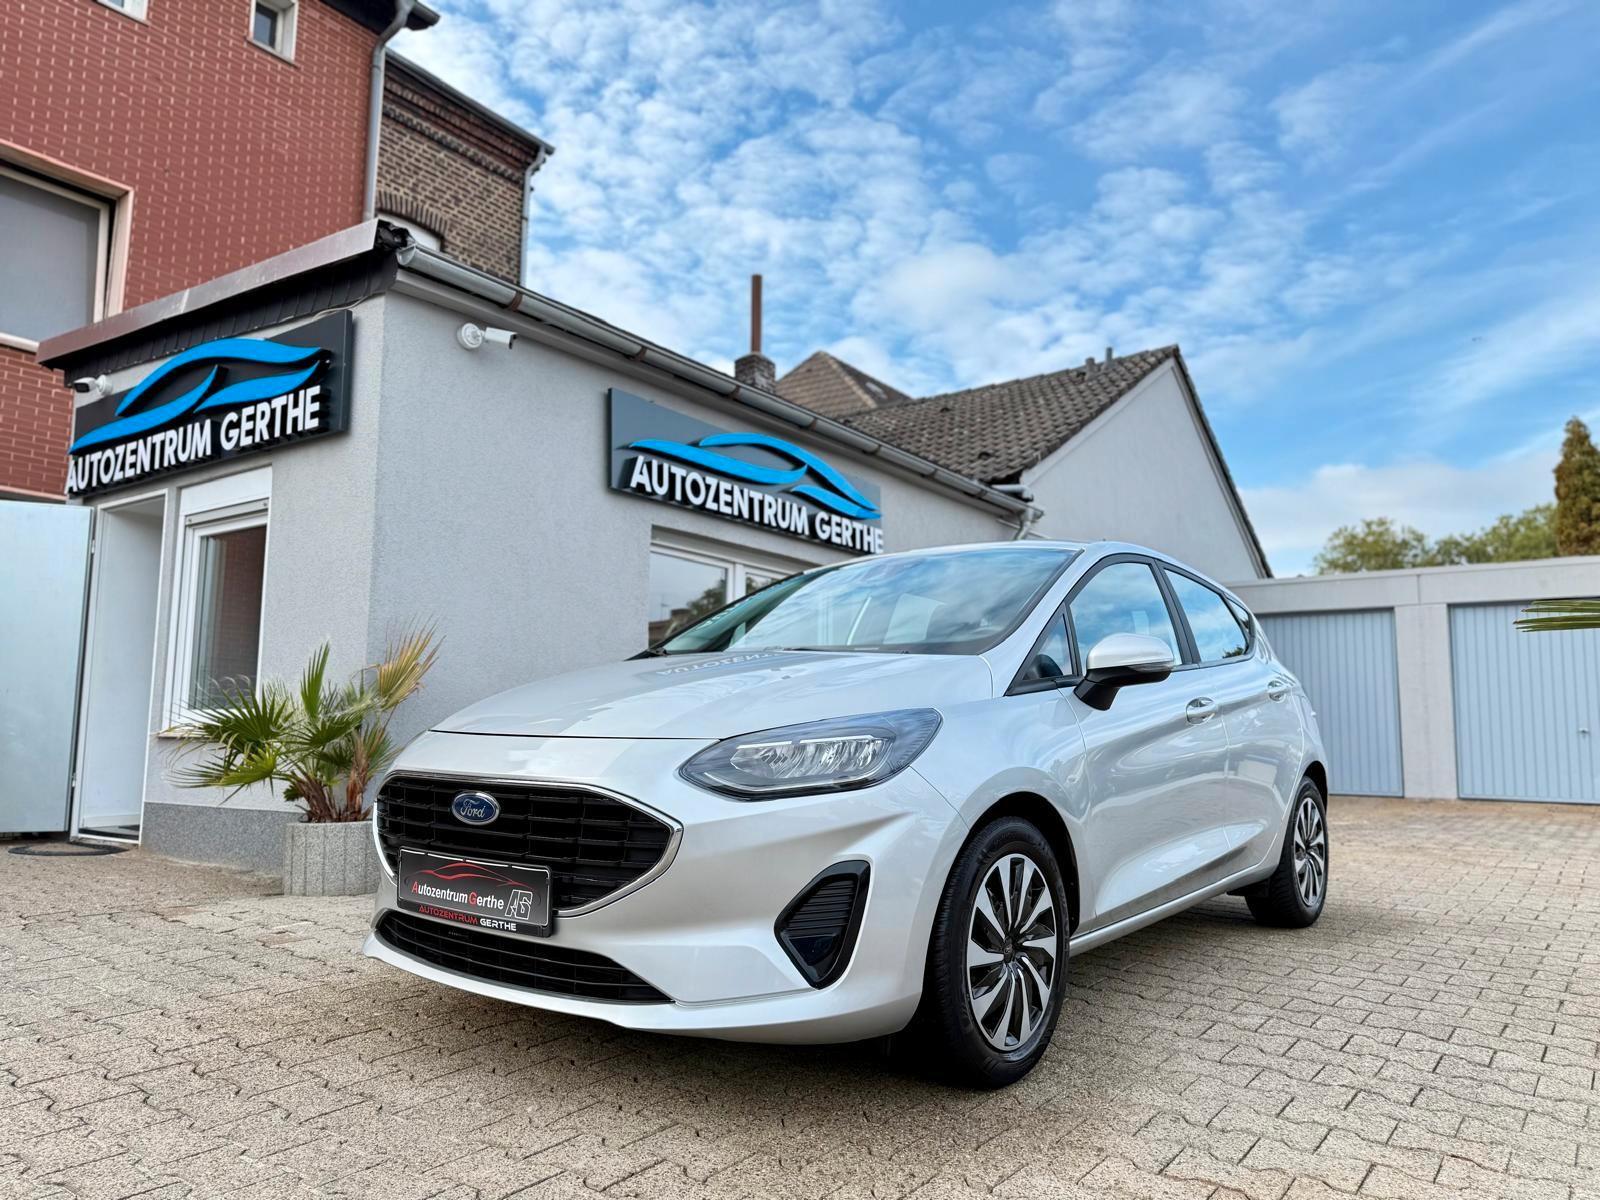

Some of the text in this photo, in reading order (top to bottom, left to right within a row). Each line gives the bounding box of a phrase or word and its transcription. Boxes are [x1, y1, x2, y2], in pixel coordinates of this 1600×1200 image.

[65, 385, 321, 494] AUTOZENTRUM GERTHE
[630, 455, 884, 554] AUTOZENTRUM GERTHE
[460, 799, 486, 818] Ford
[419, 904, 517, 931] AUTOZENTRUM GERTHE
